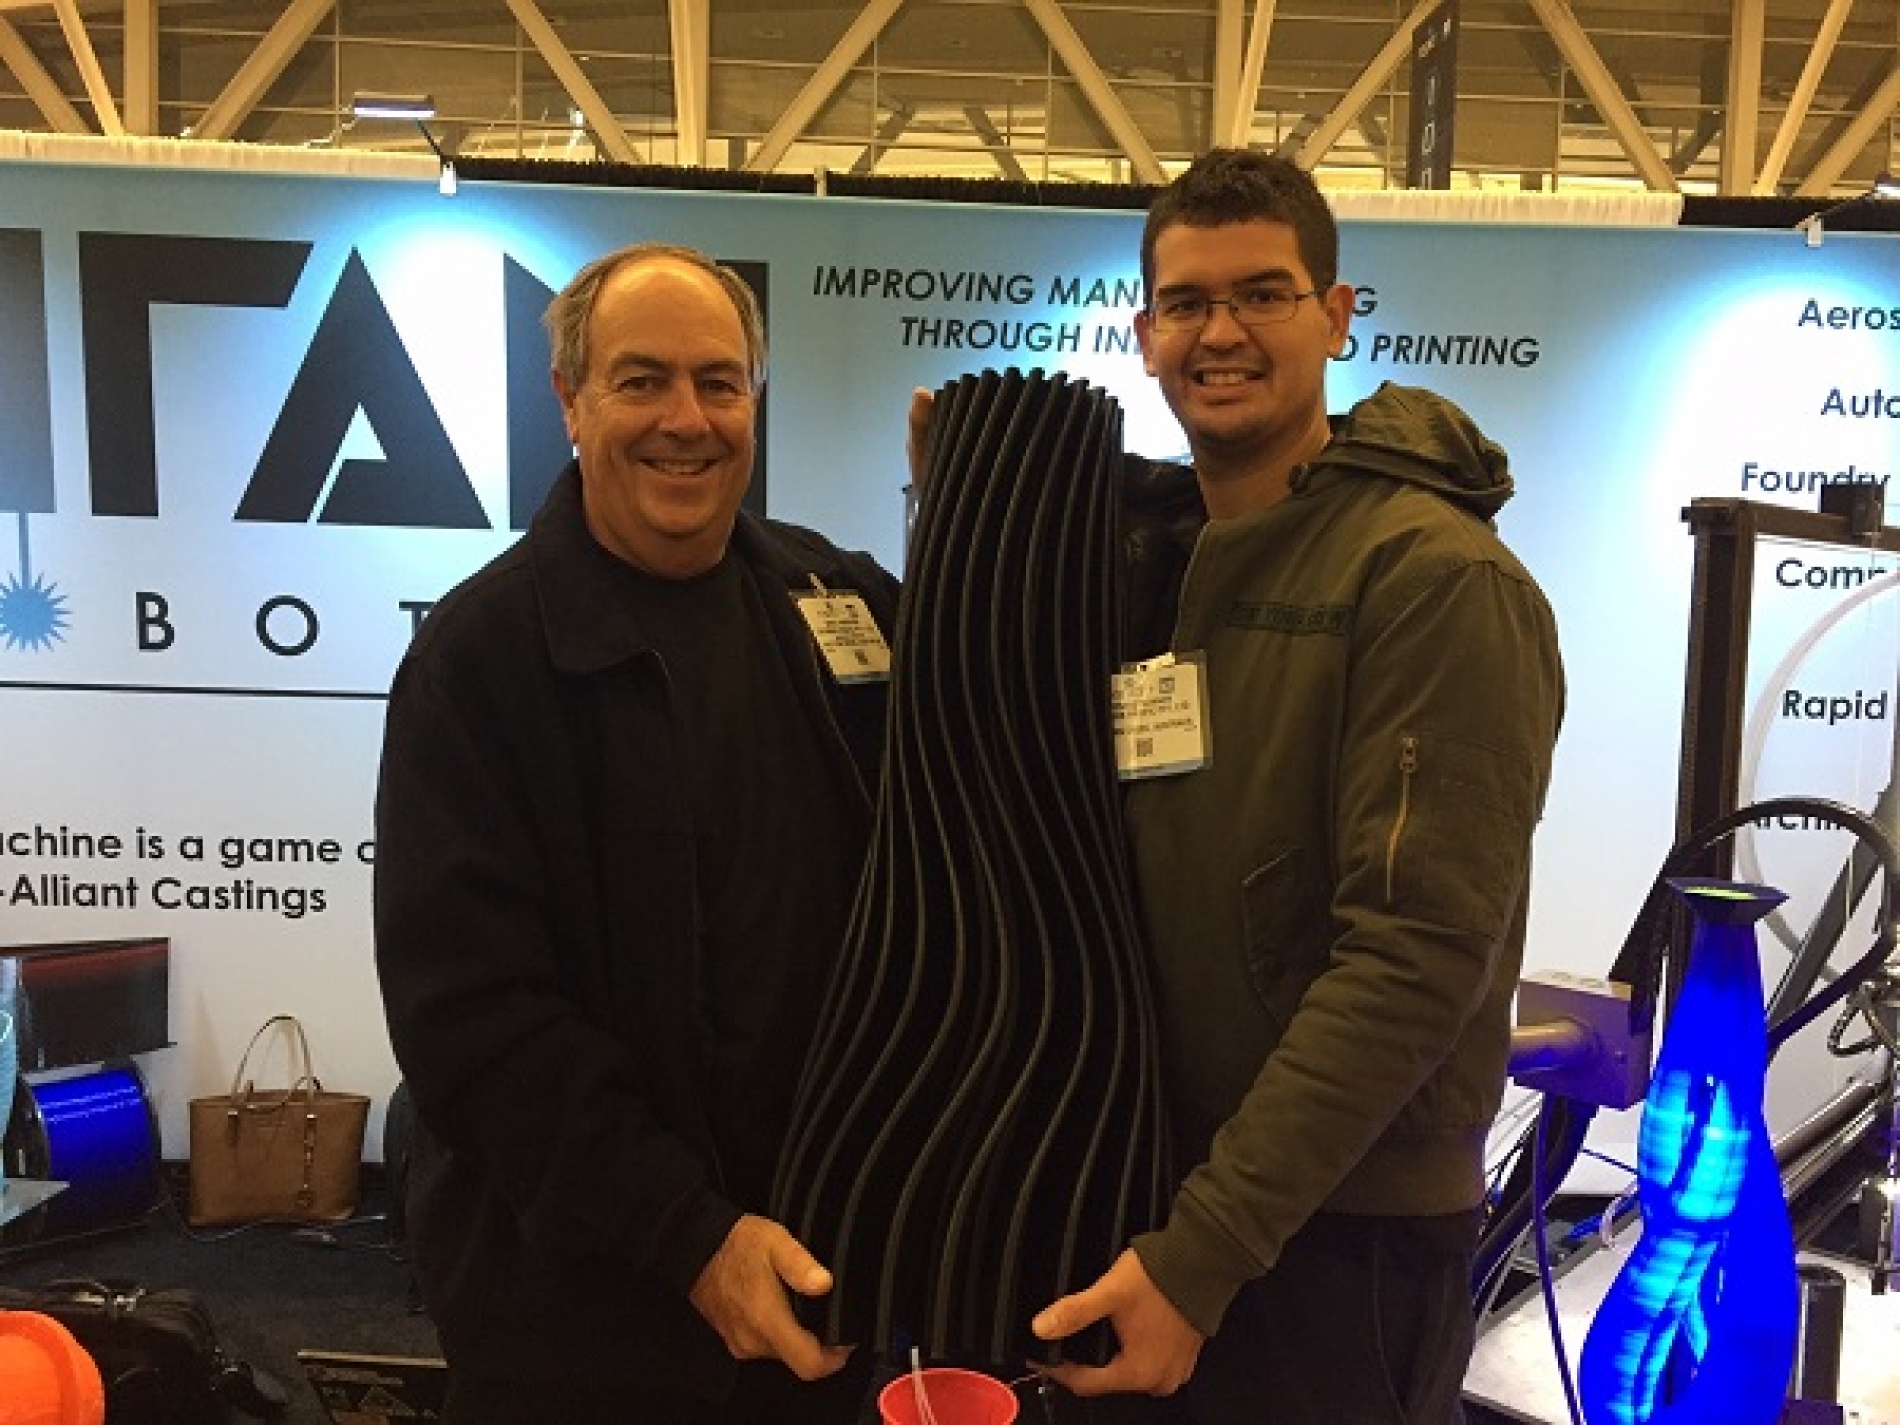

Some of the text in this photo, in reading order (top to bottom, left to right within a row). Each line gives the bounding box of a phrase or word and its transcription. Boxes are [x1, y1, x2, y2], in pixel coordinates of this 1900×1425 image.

[813, 265, 1035, 304] IMPROVING
[901, 316, 1081, 353] THROUGH
[1096, 325, 1138, 354] IN
[1371, 335, 1540, 367] PRINTING
[1782, 689, 1888, 725] Rapid
[0, 824, 122, 859] chine
[136, 826, 165, 860] is
[179, 836, 204, 861] a
[219, 836, 342, 868] game
[151, 876, 327, 918] Castings
